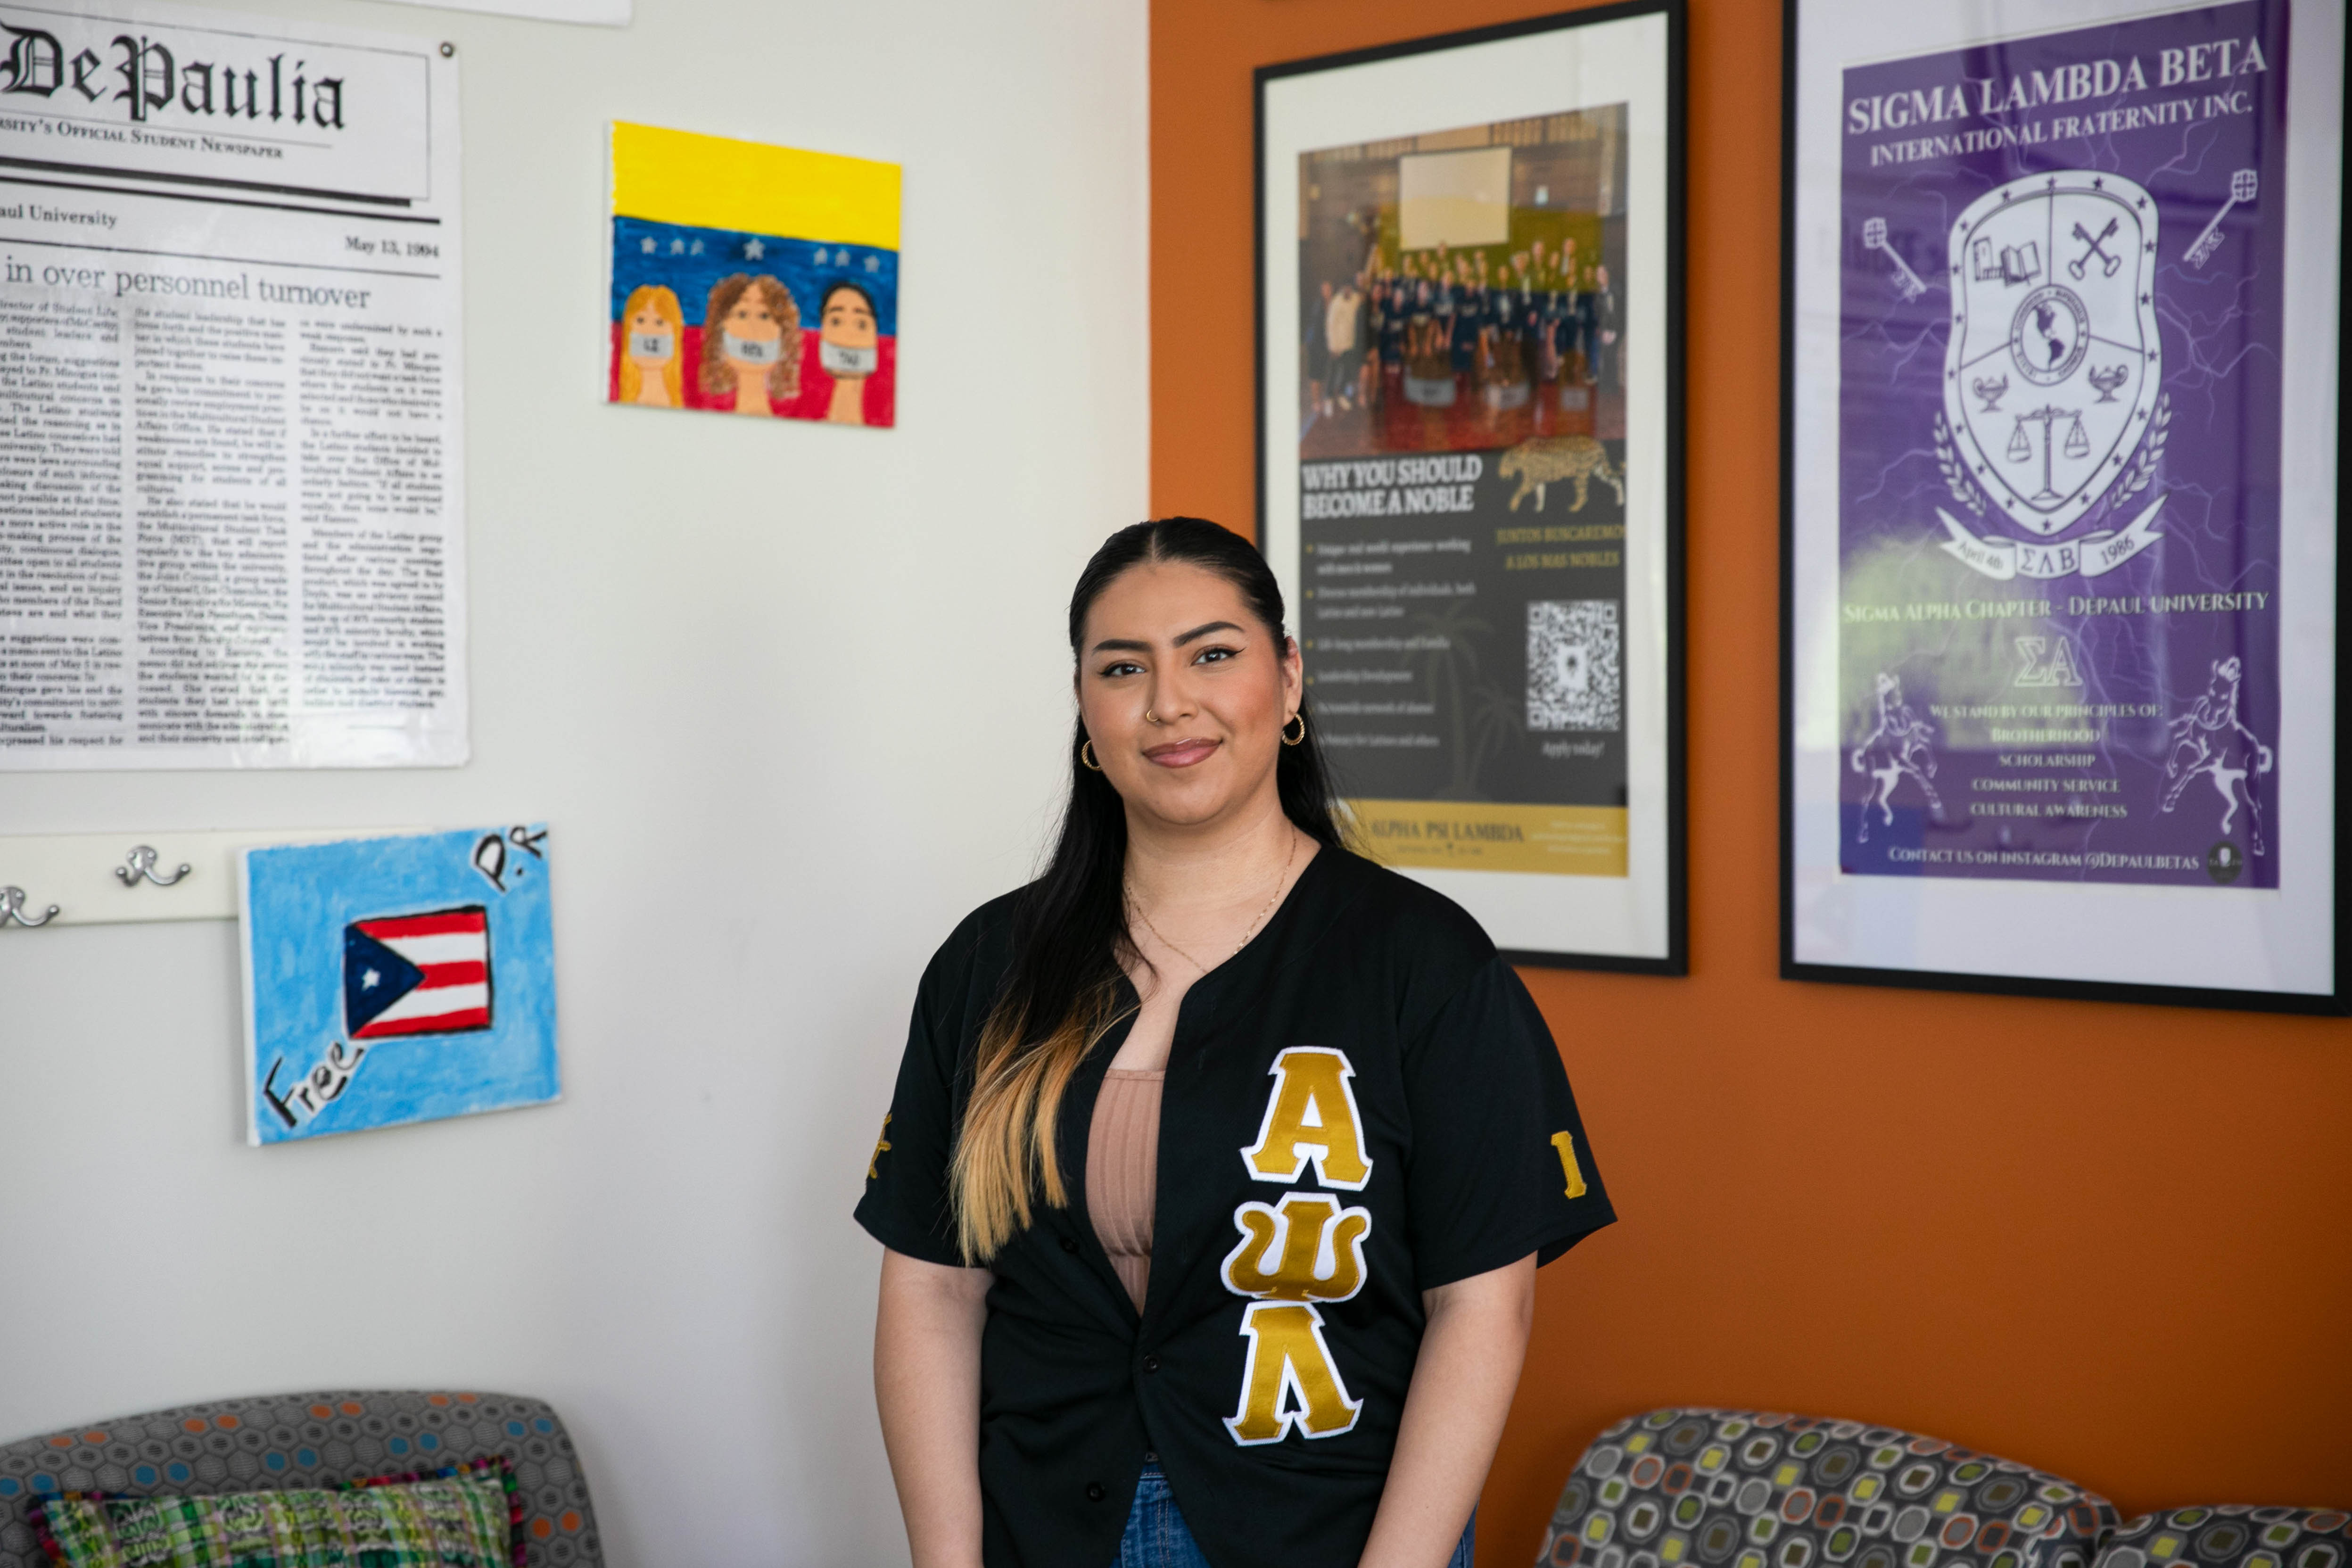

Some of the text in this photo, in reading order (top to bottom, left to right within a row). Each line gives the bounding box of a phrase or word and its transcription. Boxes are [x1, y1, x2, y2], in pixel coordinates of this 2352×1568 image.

[0, 22, 347, 130] DePaulia
[1849, 35, 2268, 135] SIGMA LAMBDA BETA
[1870, 90, 2253, 167] INTERNATIONAL FRATERNITY INC.
[29, 205, 117, 228] University
[346, 236, 375, 255] May
[406, 241, 439, 258] 1994
[6, 255, 370, 309] in over personnel turnover
[22, 378, 52, 388] Latino
[11, 403, 30, 412] The
[40, 404, 70, 414] Latino
[14, 429, 45, 438] Latino
[1303, 454, 1483, 490] WHY YOU SHOULD
[1303, 485, 1475, 519] BECOME A NOBLE
[2099, 535, 2136, 566] 1986
[1844, 602, 1900, 623] SIGMA
[1904, 601, 1961, 621] ALPHA
[1965, 599, 2052, 620] CHAPTER
[2151, 591, 2270, 614] UNIVERSITY
[2021, 705, 2053, 718] OUR
[2055, 704, 2136, 719] PRINCIPLES
[1991, 728, 2100, 743] BROTHERHOOD
[1999, 754, 2096, 768] SCHOLARSHIP
[1972, 779, 2121, 793] COMMUNITY SERVICE
[1971, 802, 2127, 819] CULTURAL AWARENESS
[1453, 822, 1525, 843] LAMBDA
[1889, 847, 1957, 864] CONTACT
[1958, 850, 1975, 864] US
[1977, 850, 1998, 865] ON
[2000, 851, 2082, 867] INSTAGRAM
[263, 1041, 366, 1129] Free
